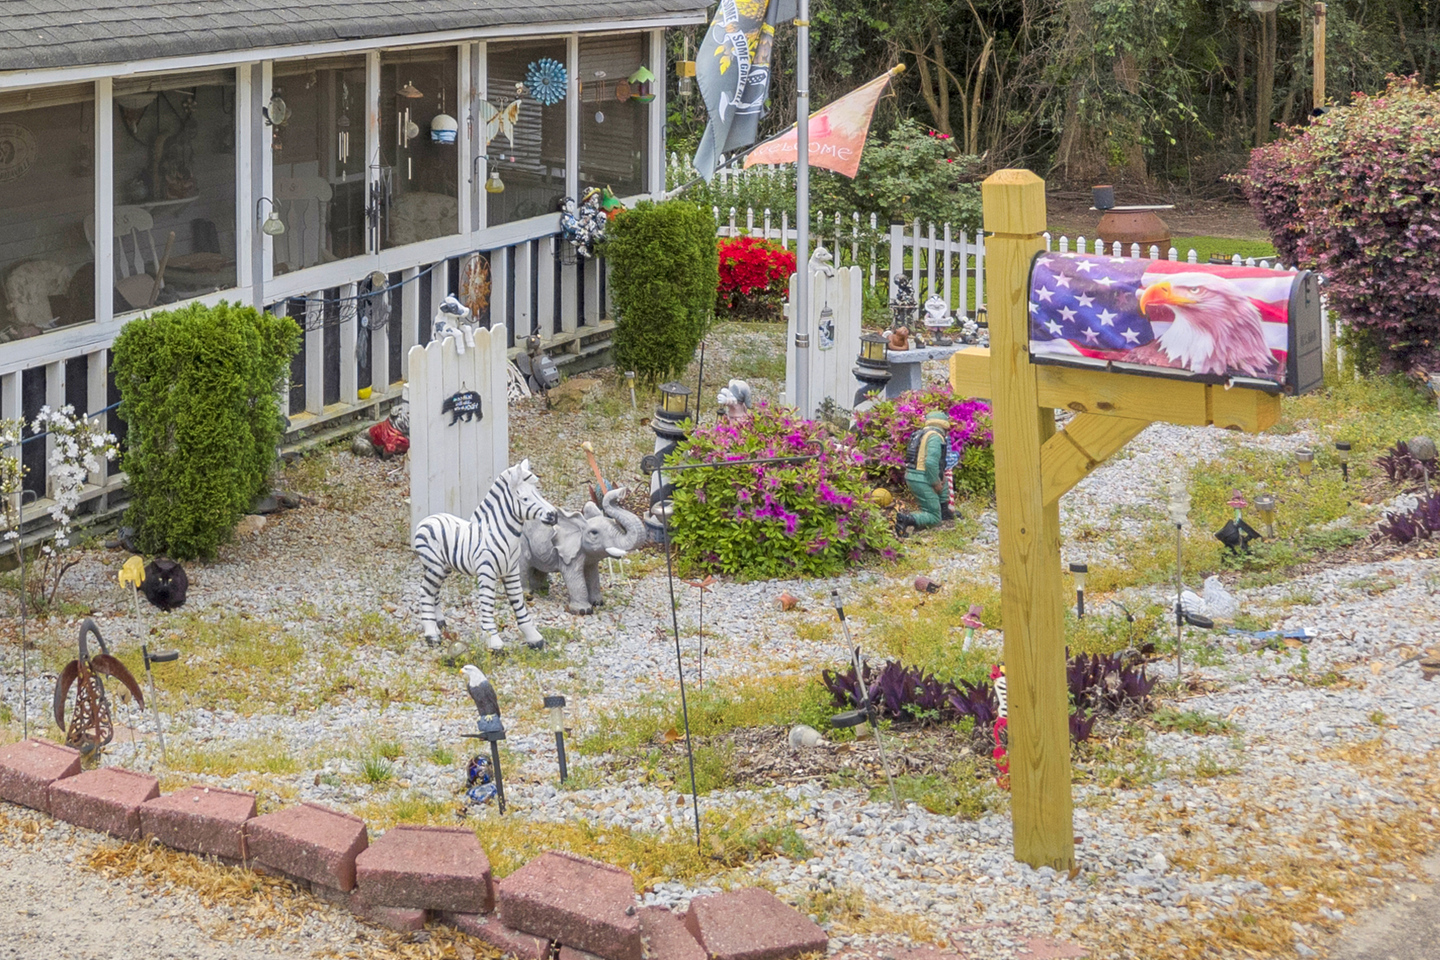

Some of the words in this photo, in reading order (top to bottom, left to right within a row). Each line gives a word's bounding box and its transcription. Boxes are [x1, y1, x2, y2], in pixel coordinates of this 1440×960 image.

[732, 34, 748, 61] SOME
[738, 65, 750, 89] GAVE
[734, 89, 744, 103] ALL
